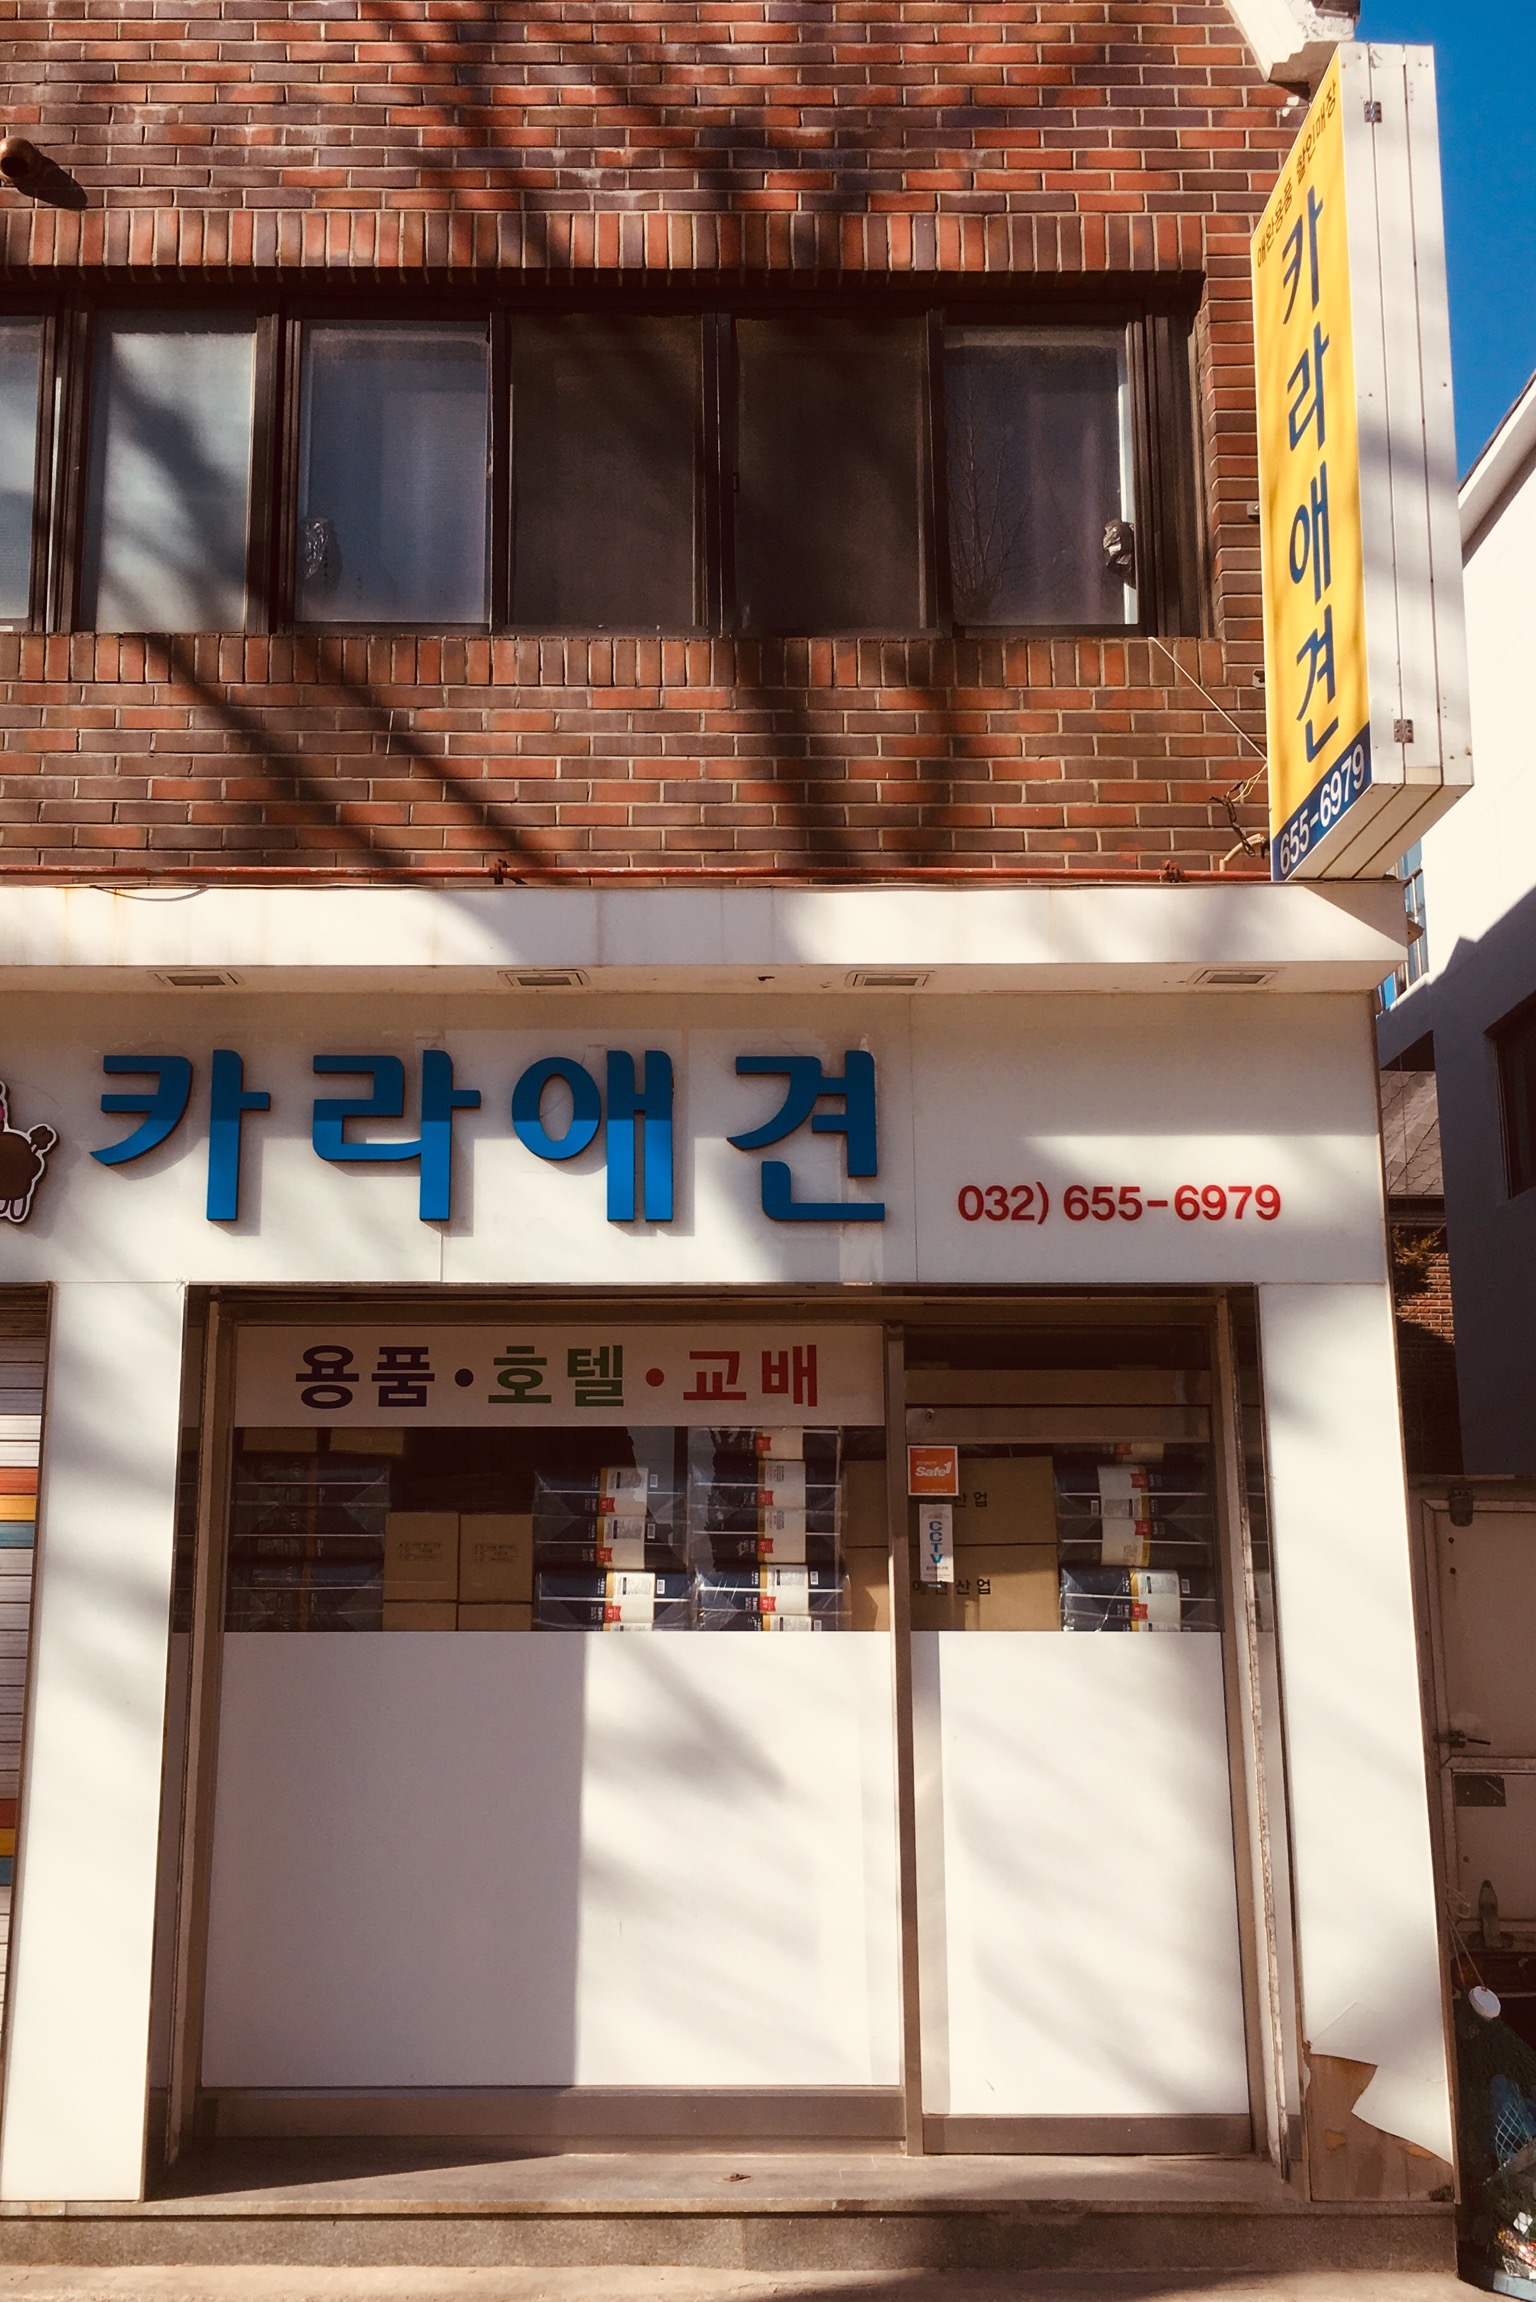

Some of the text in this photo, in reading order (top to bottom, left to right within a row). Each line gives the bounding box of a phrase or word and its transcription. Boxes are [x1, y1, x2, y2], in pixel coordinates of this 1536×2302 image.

[1257, 79, 1337, 268] 애완용품 할인매장
[1282, 184, 1339, 763] 카라애견
[1280, 744, 1364, 875] 655-6979
[88, 1049, 886, 1222] 카라애견
[957, 1181, 1281, 1225] 032) 655-6979
[929, 1520, 944, 1564] CCTV
